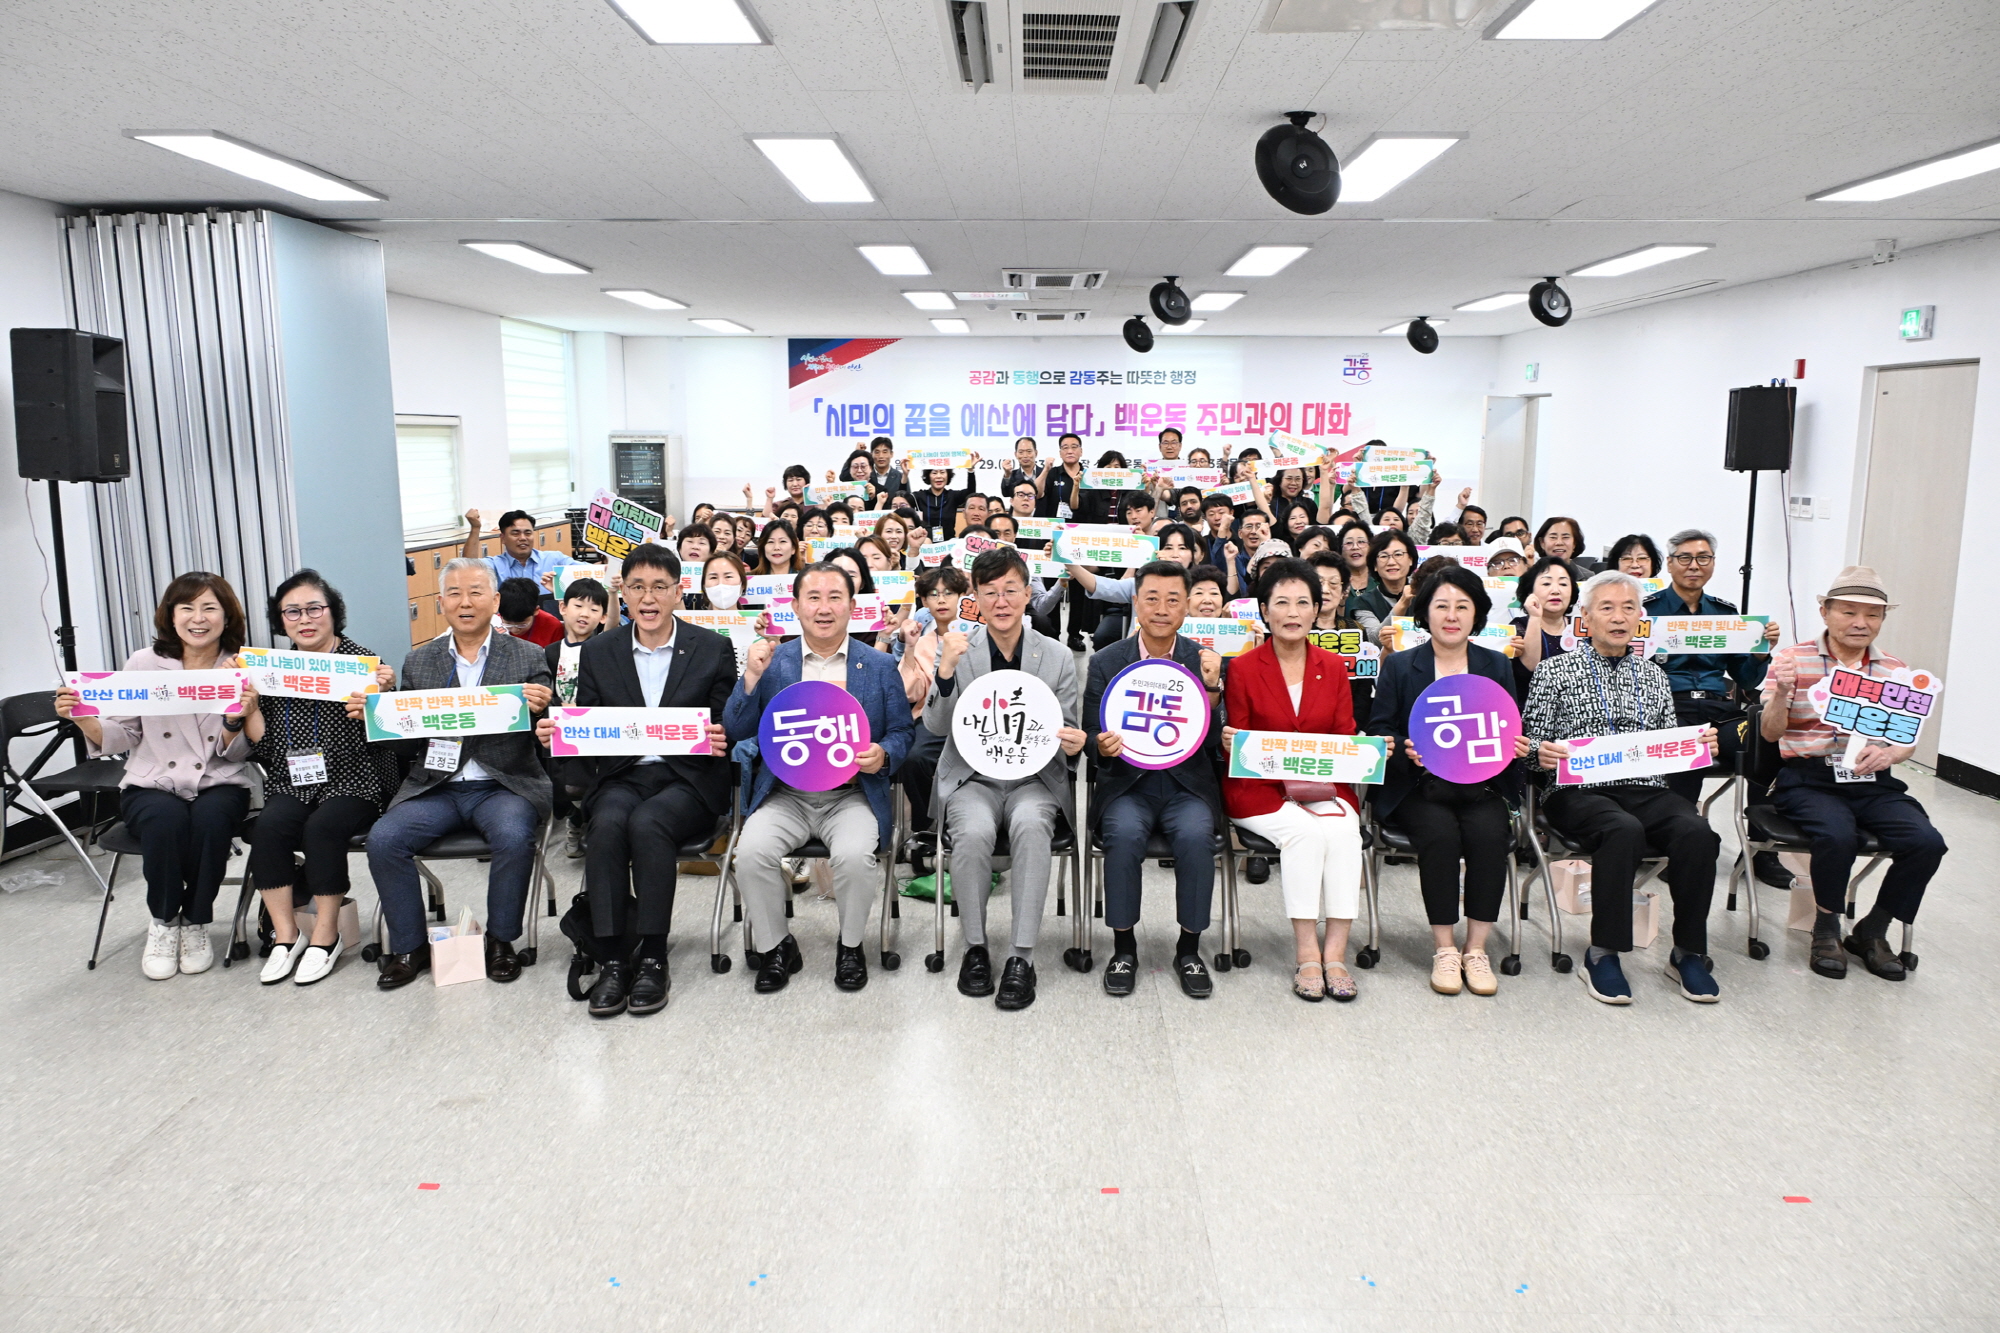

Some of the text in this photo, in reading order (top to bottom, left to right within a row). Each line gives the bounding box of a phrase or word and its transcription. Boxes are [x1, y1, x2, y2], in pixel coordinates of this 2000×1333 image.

[969, 370, 1197, 385] 공감과 동행으로 감동주는 따뜻한 행정
[1343, 358, 1372, 380] 감동
[905, 403, 950, 437] 꿈을
[960, 403, 1036, 437] 예산에
[1115, 402, 1187, 436] 백운동
[1196, 402, 1292, 436] 주민과의
[1301, 402, 1352, 436] 대화
[1273, 457, 1299, 466] 백운동
[1101, 478, 1123, 487] 백운동
[1381, 473, 1407, 483] 백운동
[588, 502, 644, 544] 대세는
[612, 499, 661, 533] 어차피
[585, 523, 641, 561] 백운
[1018, 528, 1042, 538] 백운동
[1071, 536, 1140, 549] 반짝 반짝 빛나는
[1086, 549, 1123, 563] 백운동
[573, 570, 592, 579] 반짝
[882, 575, 908, 585] 행복한
[756, 586, 772, 595] 대세
[695, 615, 715, 625] 반짝
[717, 615, 747, 625] 빛나는
[773, 612, 794, 622] 안산
[1239, 611, 1254, 620] 안산
[1196, 623, 1247, 636] 있어 행복한
[1667, 620, 1748, 632] 반짝 반짝 빛나는
[1684, 634, 1727, 649] 백운동
[245, 654, 369, 676] 정과 나눔이 있어 행복한
[1343, 655, 1378, 677] 고야!
[82, 688, 114, 701] 안산
[118, 688, 149, 701] 대세
[177, 684, 236, 701] 백운동
[283, 674, 331, 695] 백운동
[1168, 679, 1184, 692] 25
[1829, 669, 1934, 717] 매력만점
[395, 693, 499, 712] 반짝 반짝 빛나는
[422, 711, 476, 731] 백운동
[1121, 689, 1189, 747] 감동
[1824, 696, 1922, 744] 백운동
[563, 726, 590, 739] 안산
[594, 726, 621, 739] 대세
[645, 724, 699, 741] 백운동
[772, 708, 860, 768] 동행
[1425, 694, 1508, 764] 공감
[986, 745, 1029, 764] 백운동
[1261, 737, 1360, 756] 반짝 반짝 빛나는
[1570, 756, 1595, 771] 안산
[1598, 751, 1623, 767] 대세
[1646, 738, 1697, 759] 백운동
[1282, 756, 1334, 776] 백운동
